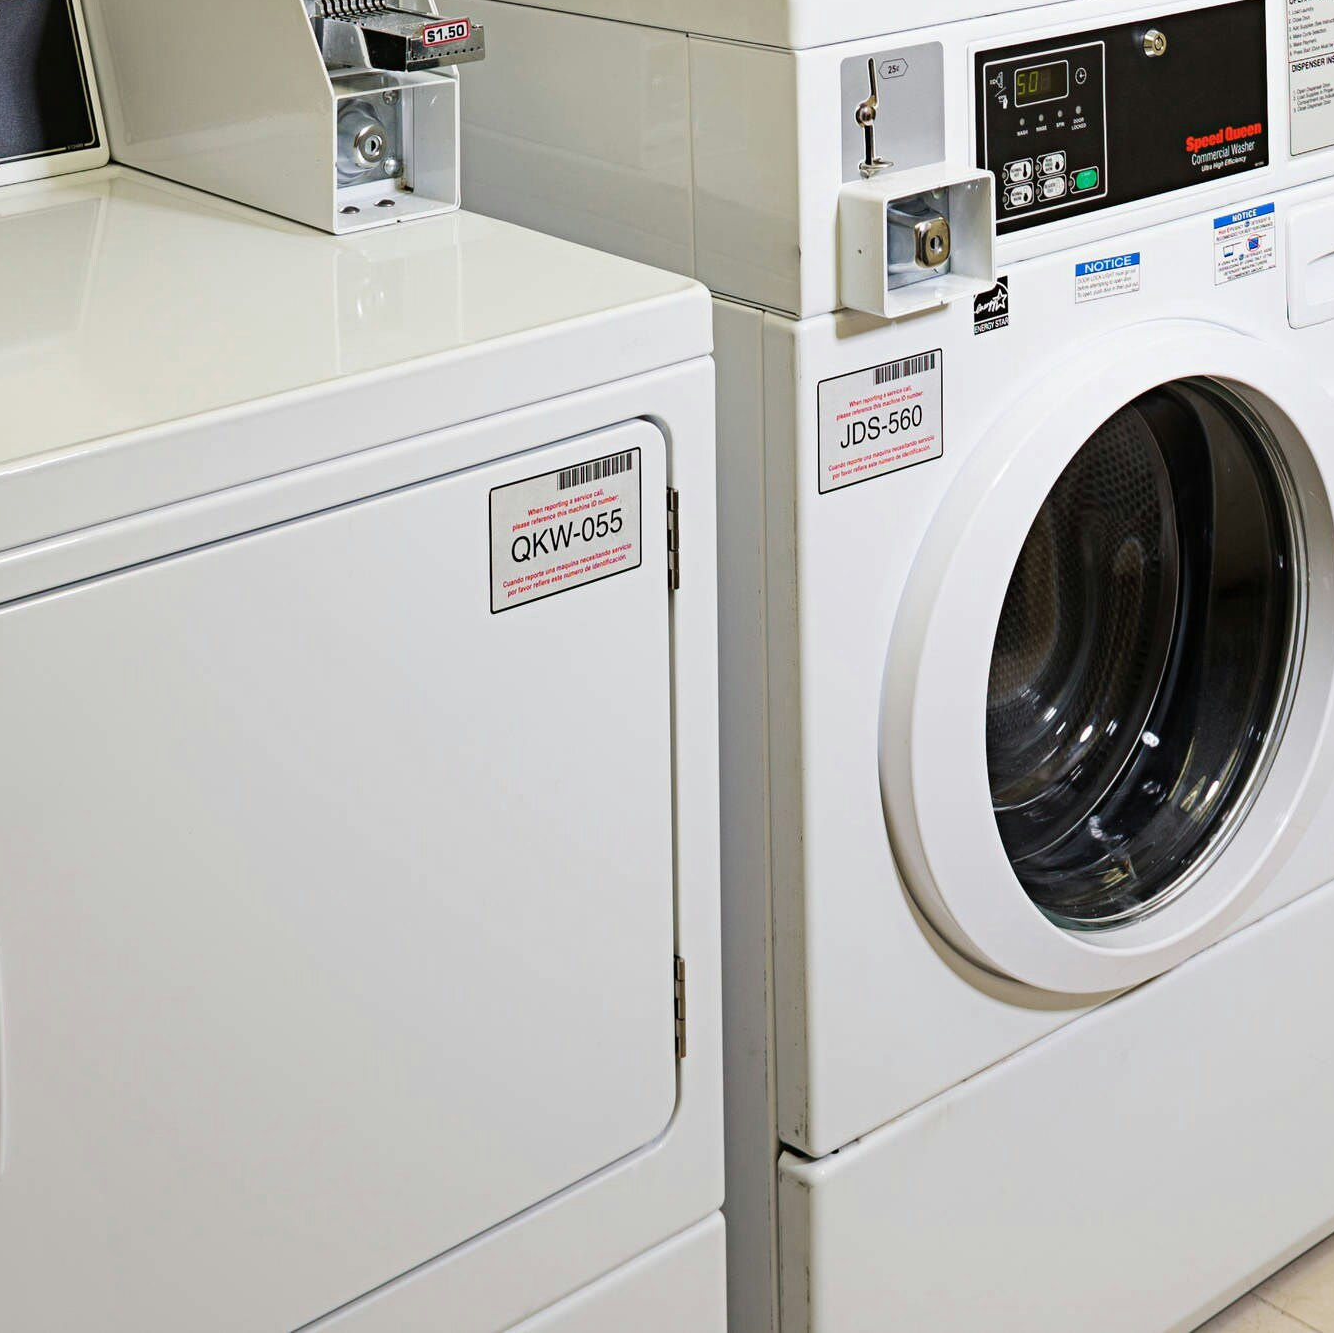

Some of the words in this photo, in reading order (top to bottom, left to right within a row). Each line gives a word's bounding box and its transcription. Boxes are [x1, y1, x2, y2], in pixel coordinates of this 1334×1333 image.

[427, 24, 465, 43] $1.50
[1291, 58, 1325, 73] DISPENSER
[1185, 129, 1224, 153] Speed
[1225, 123, 1262, 141] Queen
[1191, 146, 1230, 166] Commercial
[1231, 141, 1255, 155] Washer
[1232, 209, 1257, 222] NOTICE
[1084, 255, 1132, 273] NOTICE
[840, 404, 923, 449] JDS-560
[528, 507, 543, 517] When
[544, 500, 569, 511] reporting
[574, 493, 593, 503] service
[512, 521, 530, 532] please
[531, 513, 556, 525] reference
[557, 510, 567, 518] this
[568, 503, 590, 514] machine
[511, 508, 623, 563] QKW-055
[503, 577, 524, 588] Cuando
[525, 571, 544, 581] reporte
[545, 567, 555, 575] una
[612, 543, 632, 554] servicio
[507, 589, 517, 598] por
[518, 584, 532, 593] favor
[533, 578, 550, 588] refiere
[551, 575, 562, 583] este
